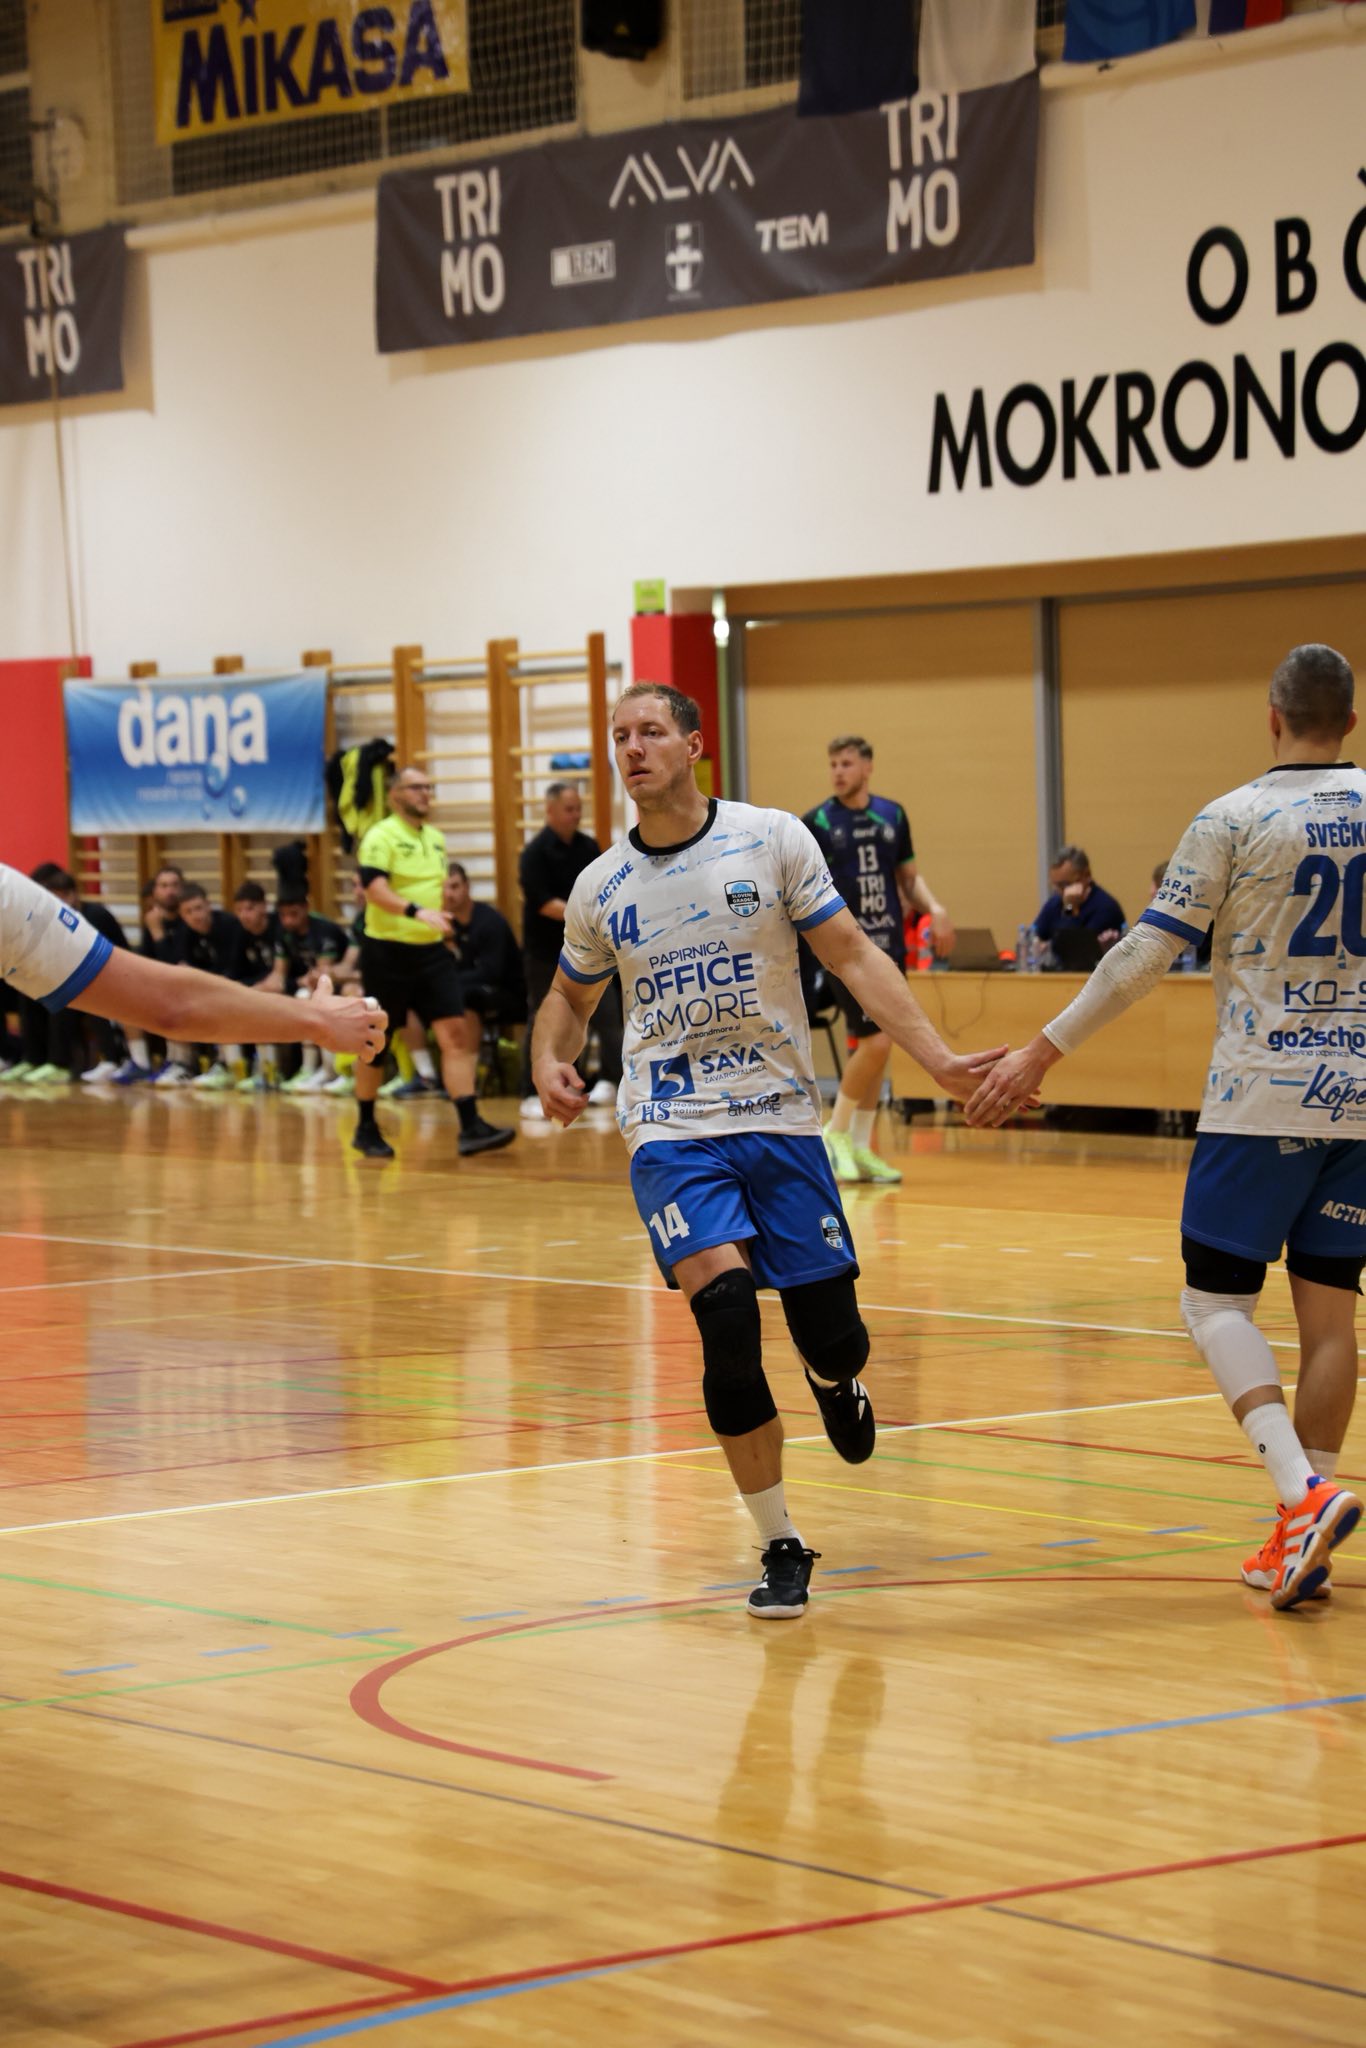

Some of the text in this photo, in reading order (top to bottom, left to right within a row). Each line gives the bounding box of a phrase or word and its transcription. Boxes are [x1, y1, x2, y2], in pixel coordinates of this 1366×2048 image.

[177, 0, 450, 129] MIKASA
[880, 92, 960, 169] TRI
[609, 137, 756, 209] ALVA
[433, 168, 500, 243] TRI
[755, 211, 829, 253] TEM
[887, 169, 960, 253] MO
[15, 242, 75, 310] TRI
[441, 243, 504, 317] MO
[24, 309, 81, 378] MO
[927, 341, 1366, 494] MOKRONO
[1305, 815, 1366, 848] SVEČK
[597, 861, 634, 908] ACTIVE
[857, 844, 879, 873] 13
[1161, 877, 1191, 897] ARA
[607, 903, 641, 951] 14
[634, 952, 755, 1005] OFFICE
[648, 940, 729, 969] PAPIRNICA
[641, 987, 762, 1040] &MORE
[699, 1045, 766, 1075] SAVA
[703, 1064, 768, 1084] ZAVAROVALNICA
[648, 1201, 691, 1250] 14
